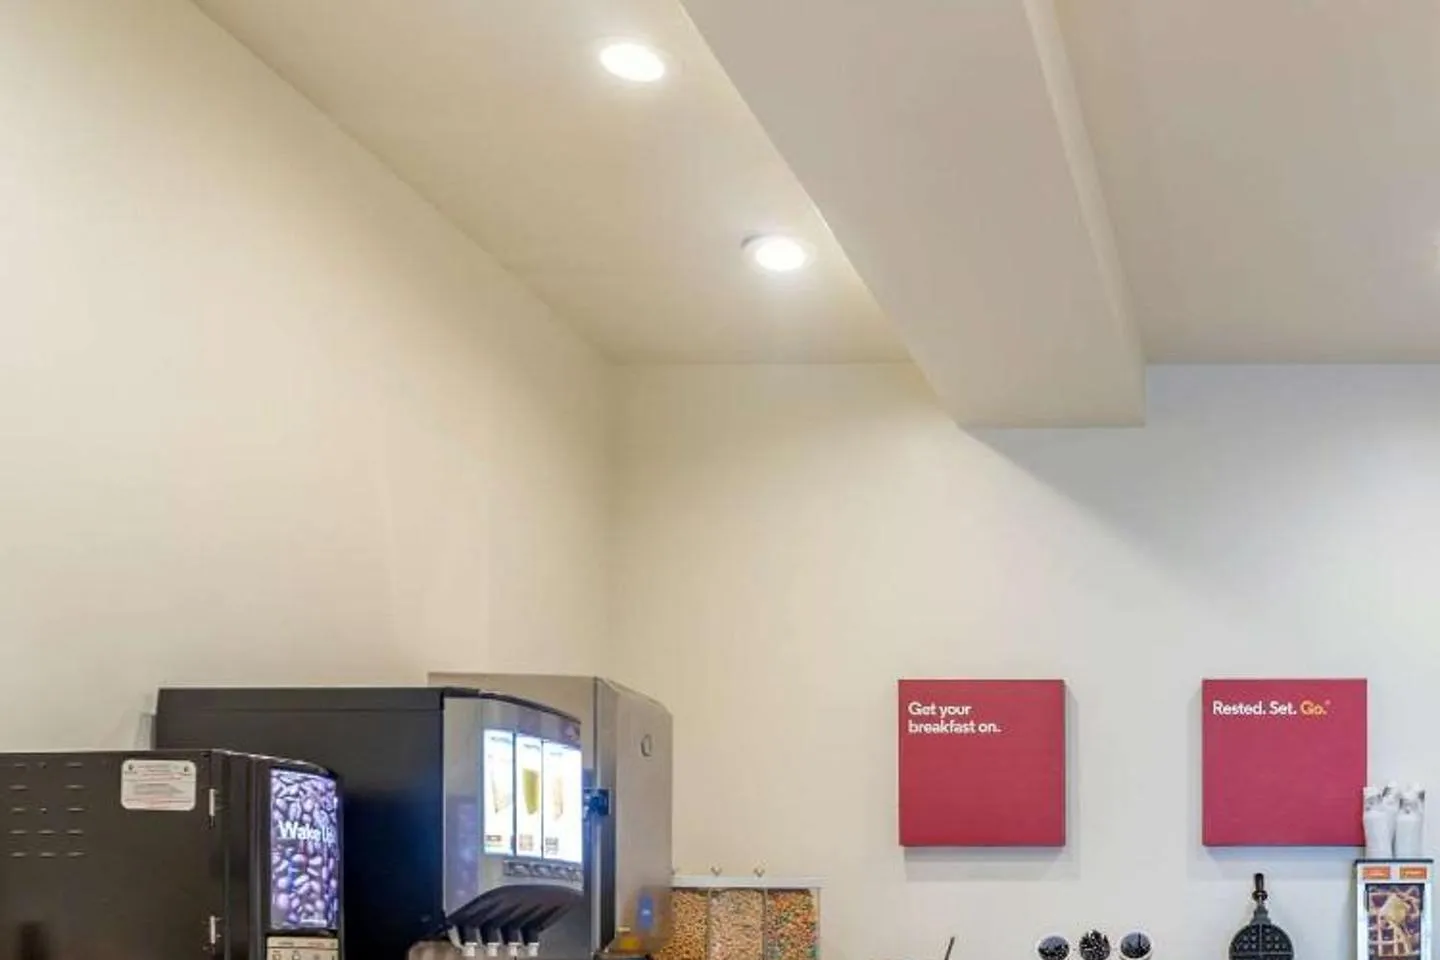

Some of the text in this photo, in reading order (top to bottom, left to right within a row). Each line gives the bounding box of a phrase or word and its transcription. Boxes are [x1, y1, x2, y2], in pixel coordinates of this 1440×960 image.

[908, 701, 972, 718] Get your
[1213, 700, 1266, 715] Rested.
[1269, 700, 1297, 715] Set.
[908, 719, 1002, 733] breakfast on.
[278, 820, 321, 841] Wake
